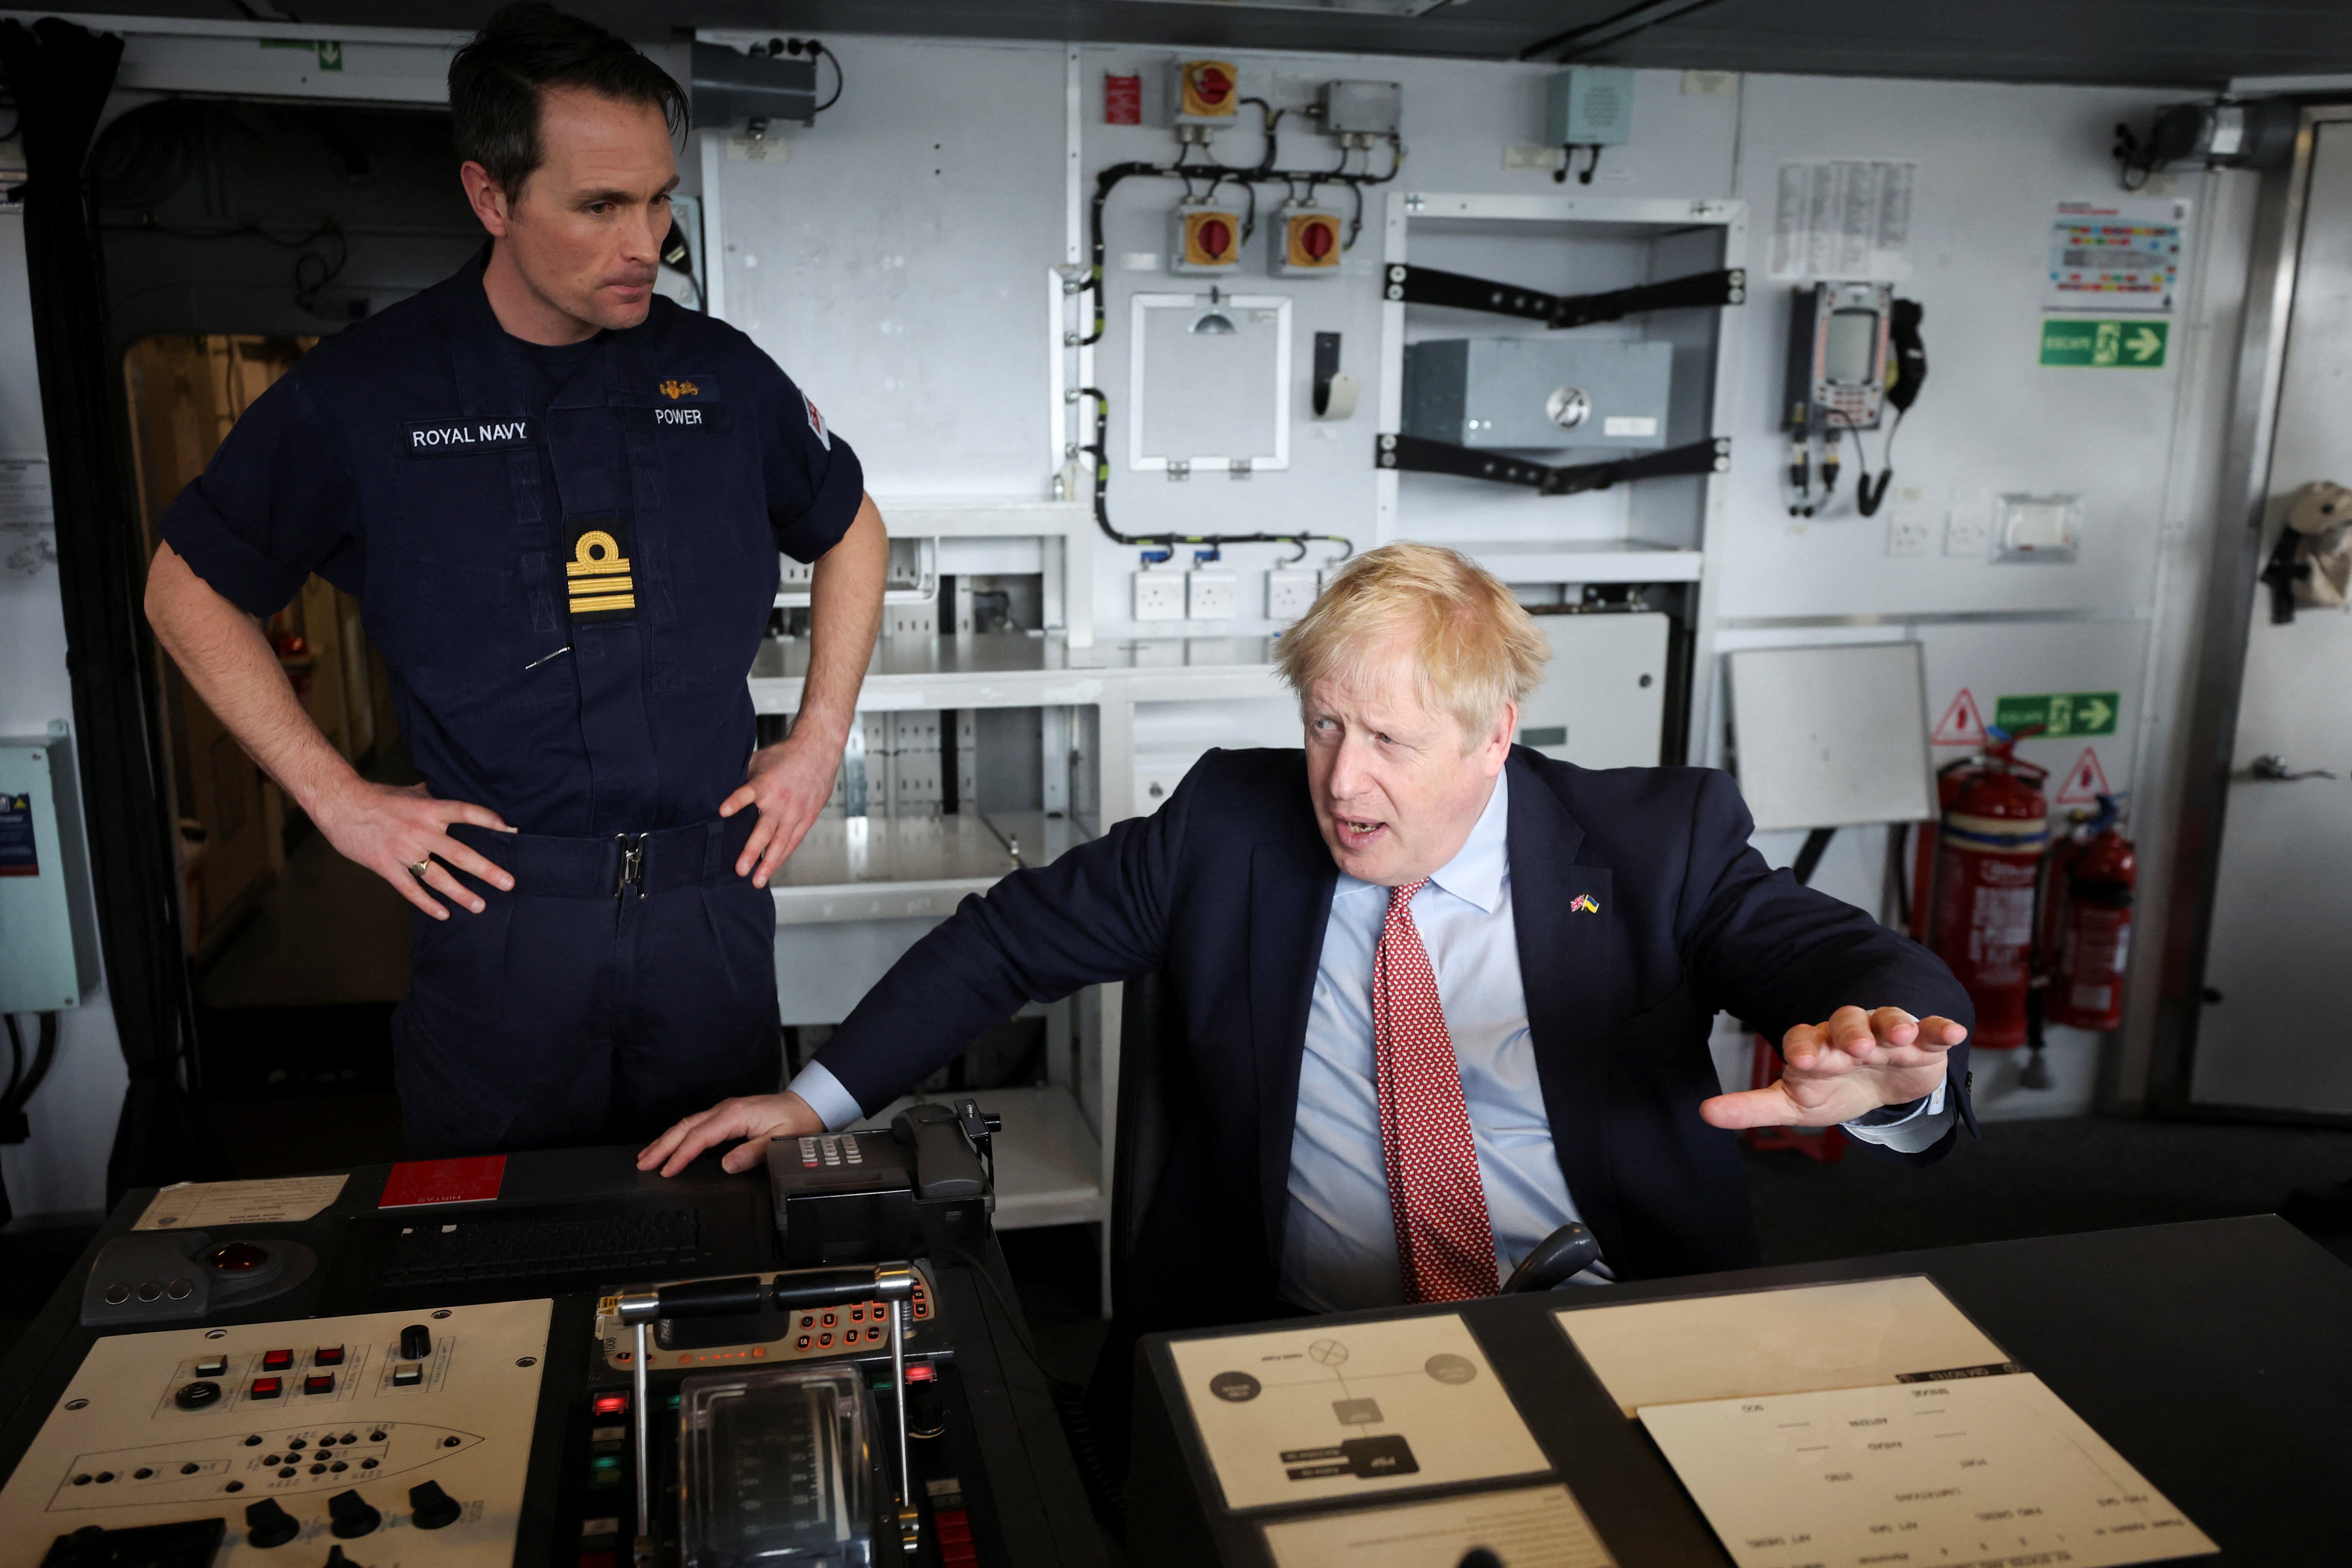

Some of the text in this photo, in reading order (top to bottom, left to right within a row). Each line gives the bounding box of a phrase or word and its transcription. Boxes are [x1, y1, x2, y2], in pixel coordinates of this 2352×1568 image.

[655, 408, 702, 425] POWER
[413, 421, 528, 448] ROYAL NAVY
[605, 1337, 616, 1353] 1006
